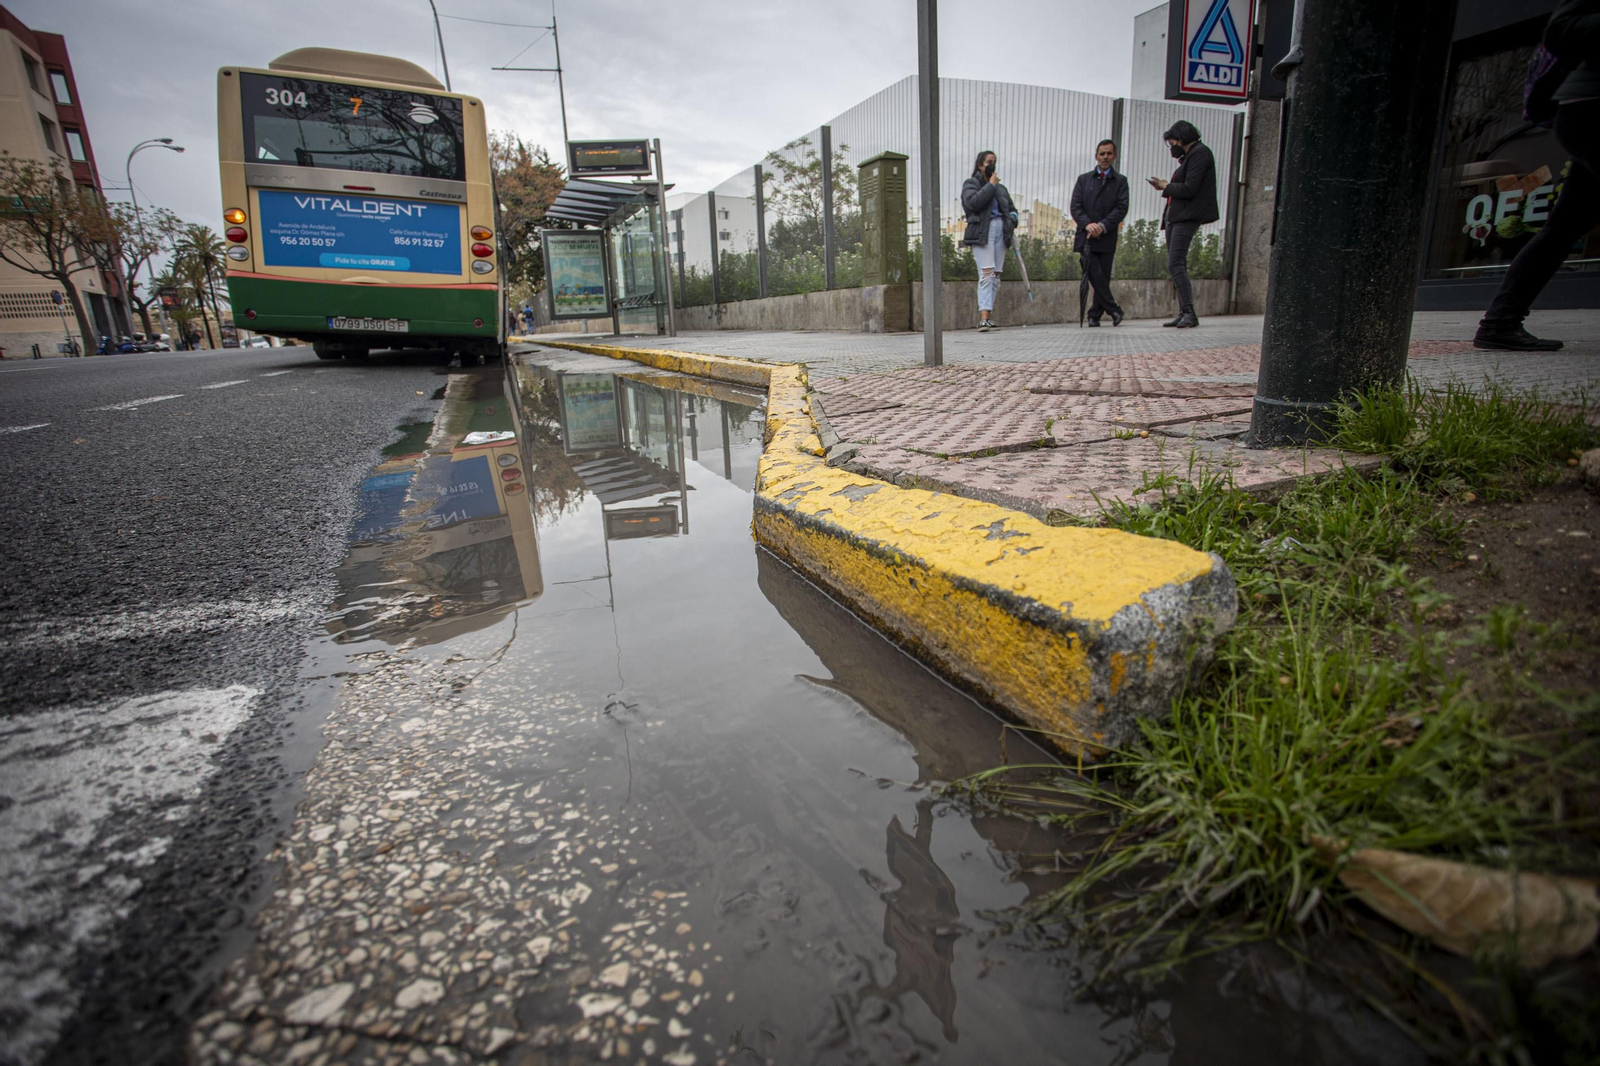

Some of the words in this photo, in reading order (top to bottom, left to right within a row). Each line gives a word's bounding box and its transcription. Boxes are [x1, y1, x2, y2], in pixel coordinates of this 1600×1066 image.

[1193, 64, 1238, 85] ALDI
[265, 87, 308, 109] 304
[350, 97, 362, 116] 7
[419, 190, 462, 200] Castrosua
[294, 196, 427, 217] VITALDENT
[1465, 184, 1561, 228] OFE
[280, 236, 297, 245] 956
[299, 237, 310, 246] 20
[312, 238, 323, 246] 50
[325, 239, 336, 247] 57
[394, 236, 410, 246] 856
[412, 237, 421, 246] 91
[423, 238, 433, 247] 32
[434, 239, 444, 248] 57
[334, 320, 360, 329] 0799
[363, 320, 382, 330] DSG
[388, 322, 405, 331] SP
